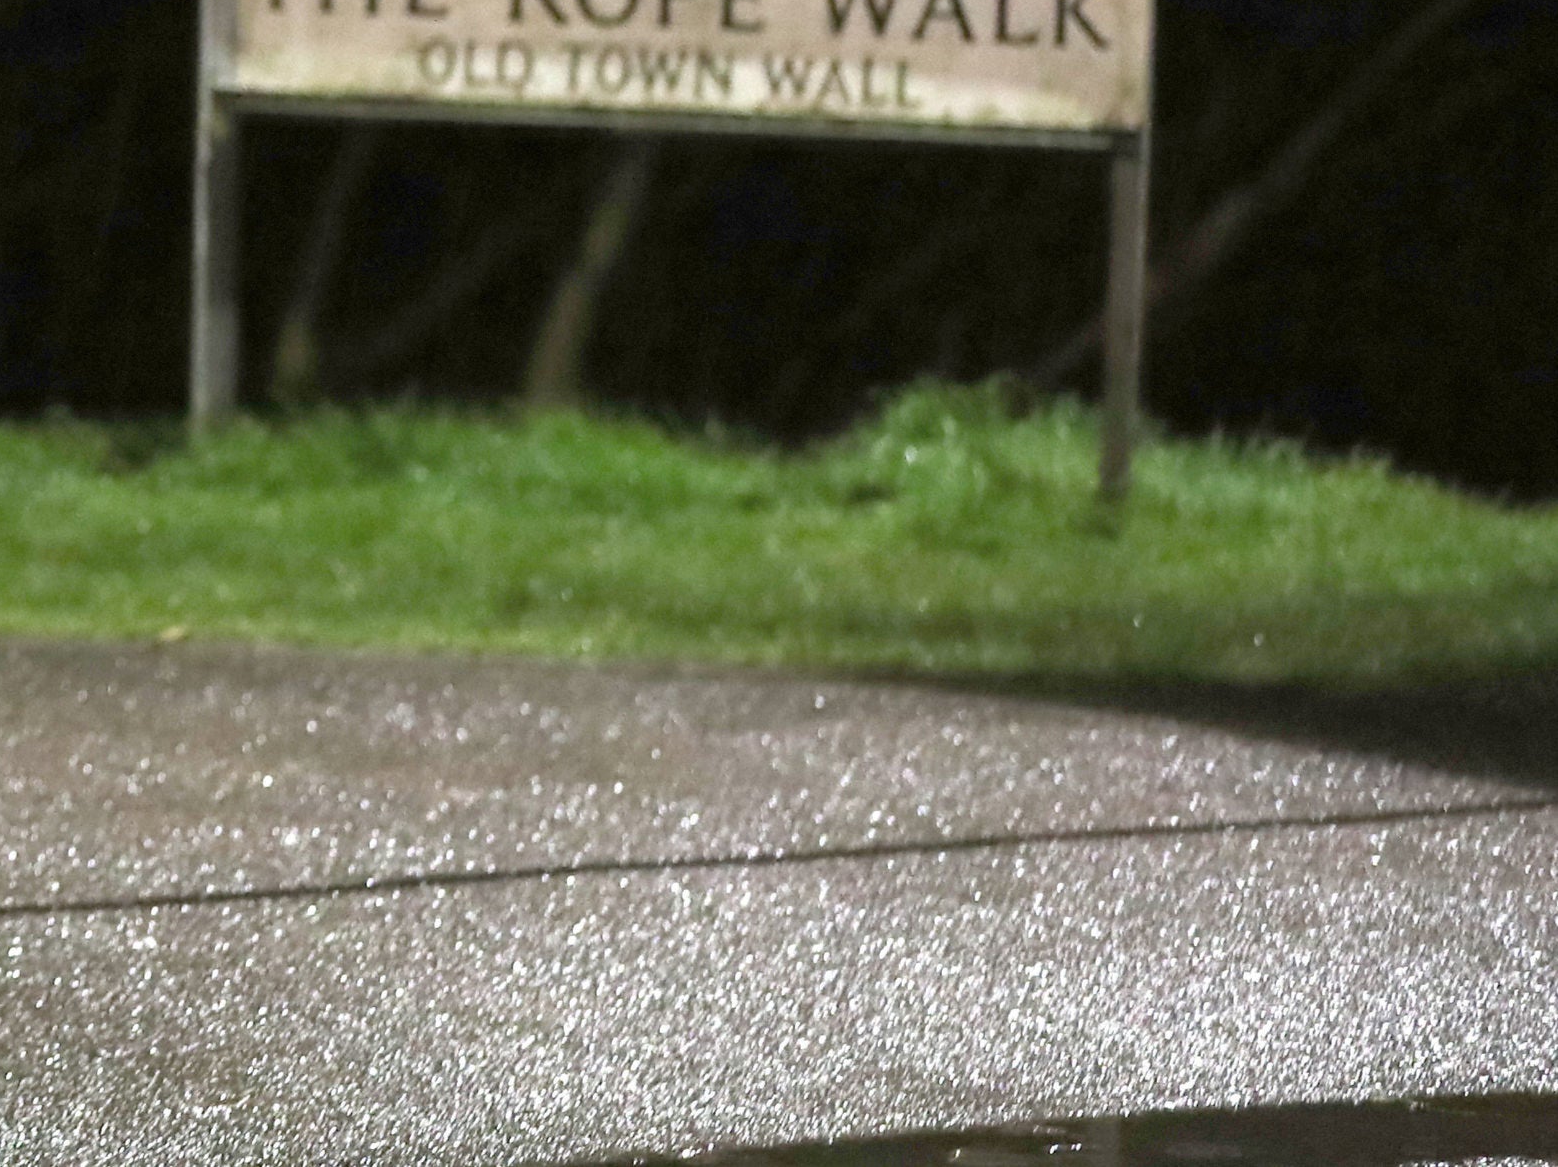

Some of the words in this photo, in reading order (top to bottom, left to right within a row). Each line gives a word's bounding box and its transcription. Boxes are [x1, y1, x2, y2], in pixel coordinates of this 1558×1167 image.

[419, 38, 535, 90] OLD
[560, 40, 732, 100] TOWN
[764, 52, 920, 109] WALL
